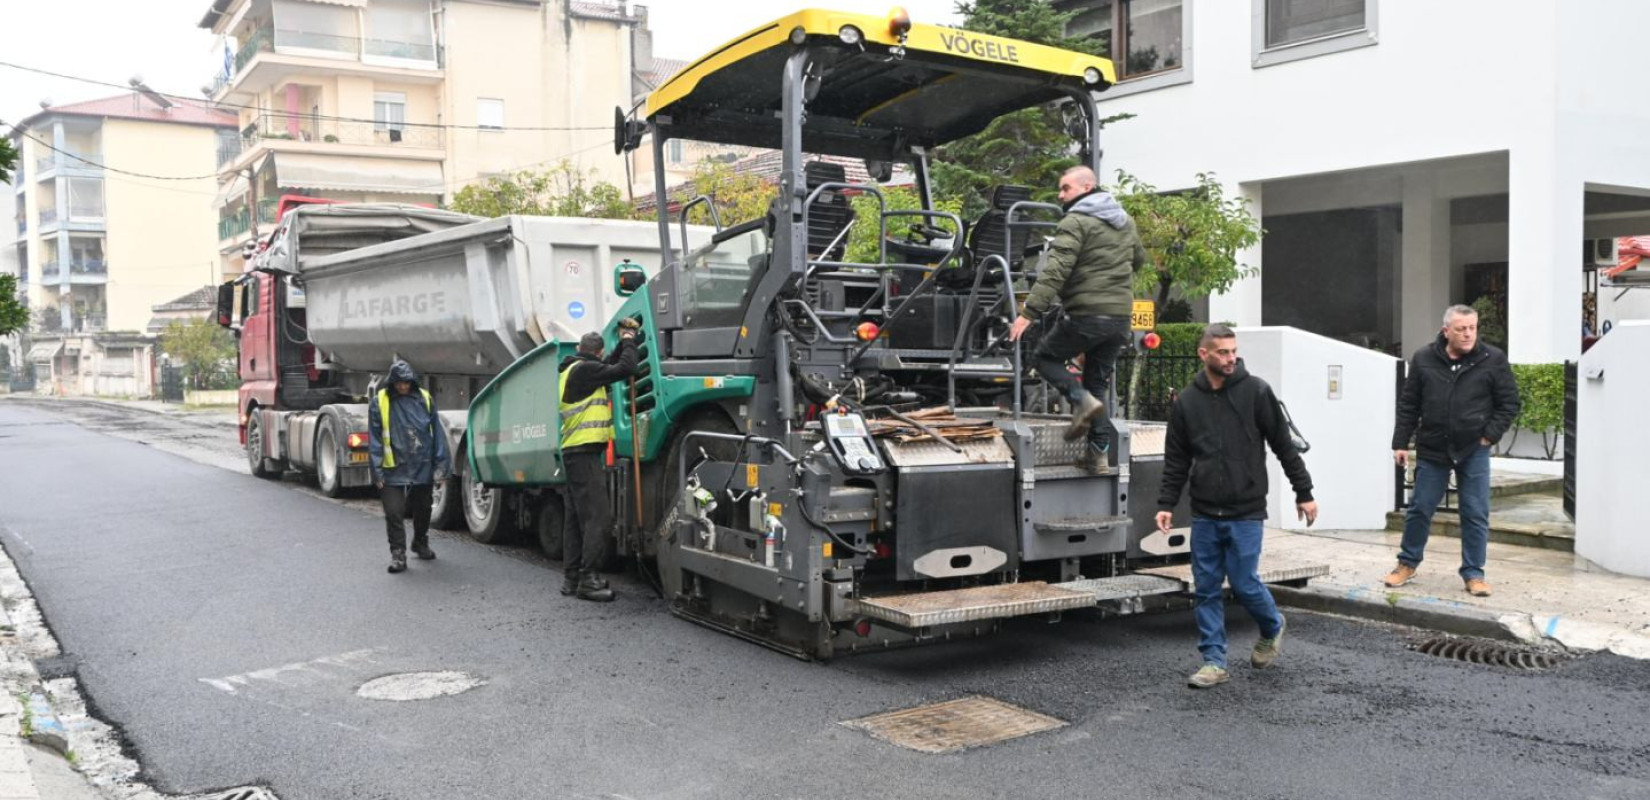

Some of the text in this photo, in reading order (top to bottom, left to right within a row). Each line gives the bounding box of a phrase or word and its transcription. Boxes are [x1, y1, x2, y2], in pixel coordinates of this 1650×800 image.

[940, 31, 1019, 63] VÖGELE
[343, 291, 446, 319] LAFARGE
[521, 423, 547, 440] VÖGELE
